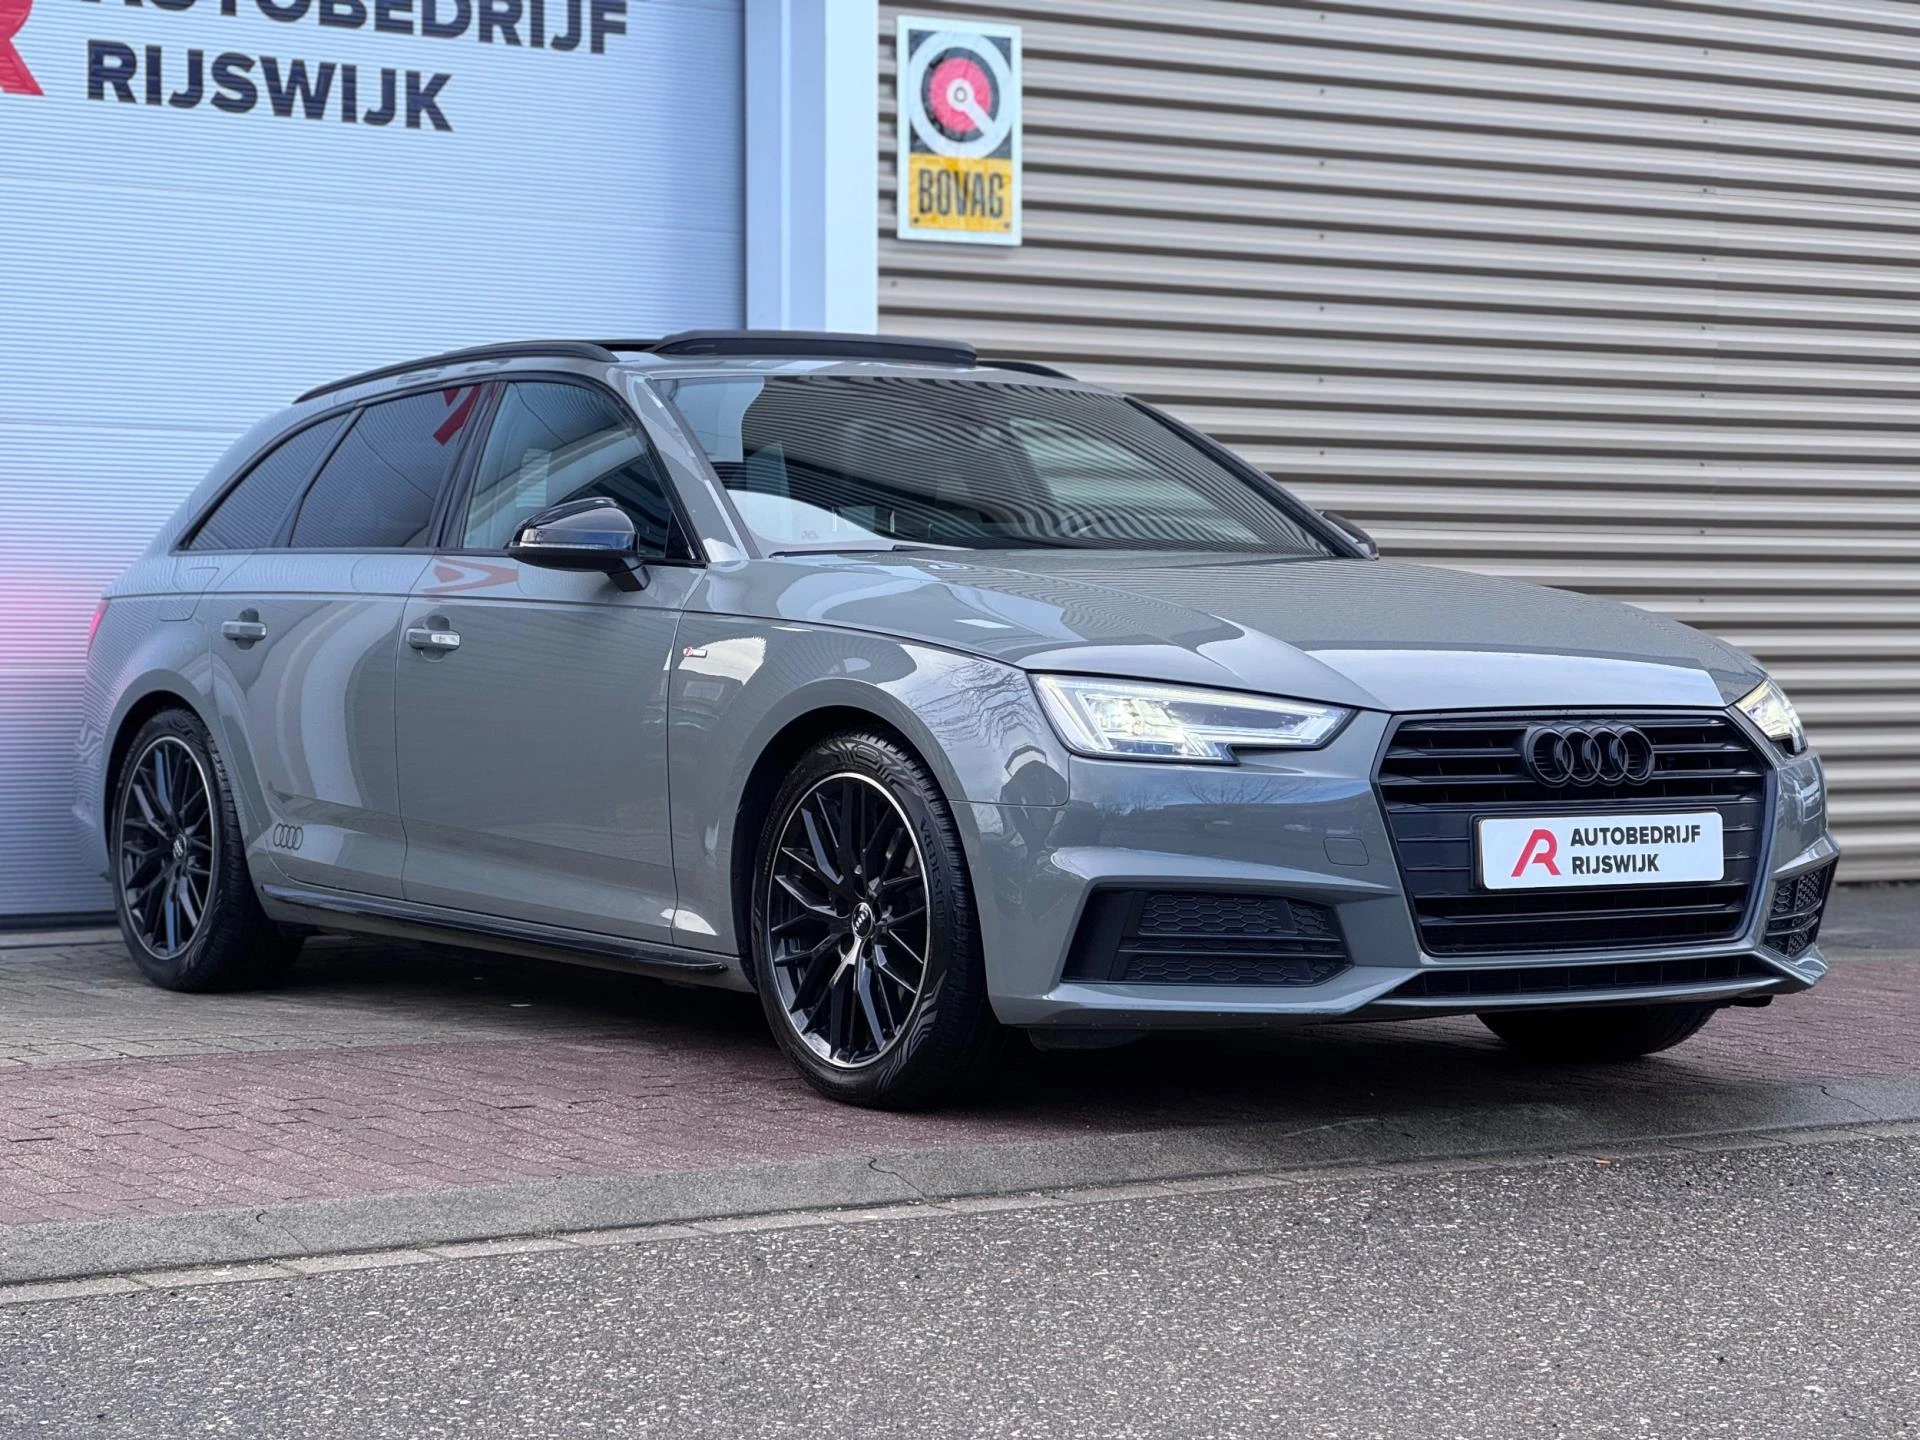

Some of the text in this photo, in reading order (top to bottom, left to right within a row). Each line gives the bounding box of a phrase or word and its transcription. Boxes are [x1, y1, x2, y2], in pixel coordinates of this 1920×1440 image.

[79, 0, 628, 54] EDRIJF
[87, 39, 453, 131] RIJSWIJK
[918, 168, 1004, 219] BOVAG
[1570, 824, 1701, 847] AUTOBEDRIJF
[1571, 853, 1660, 875] RIJSWIJK
